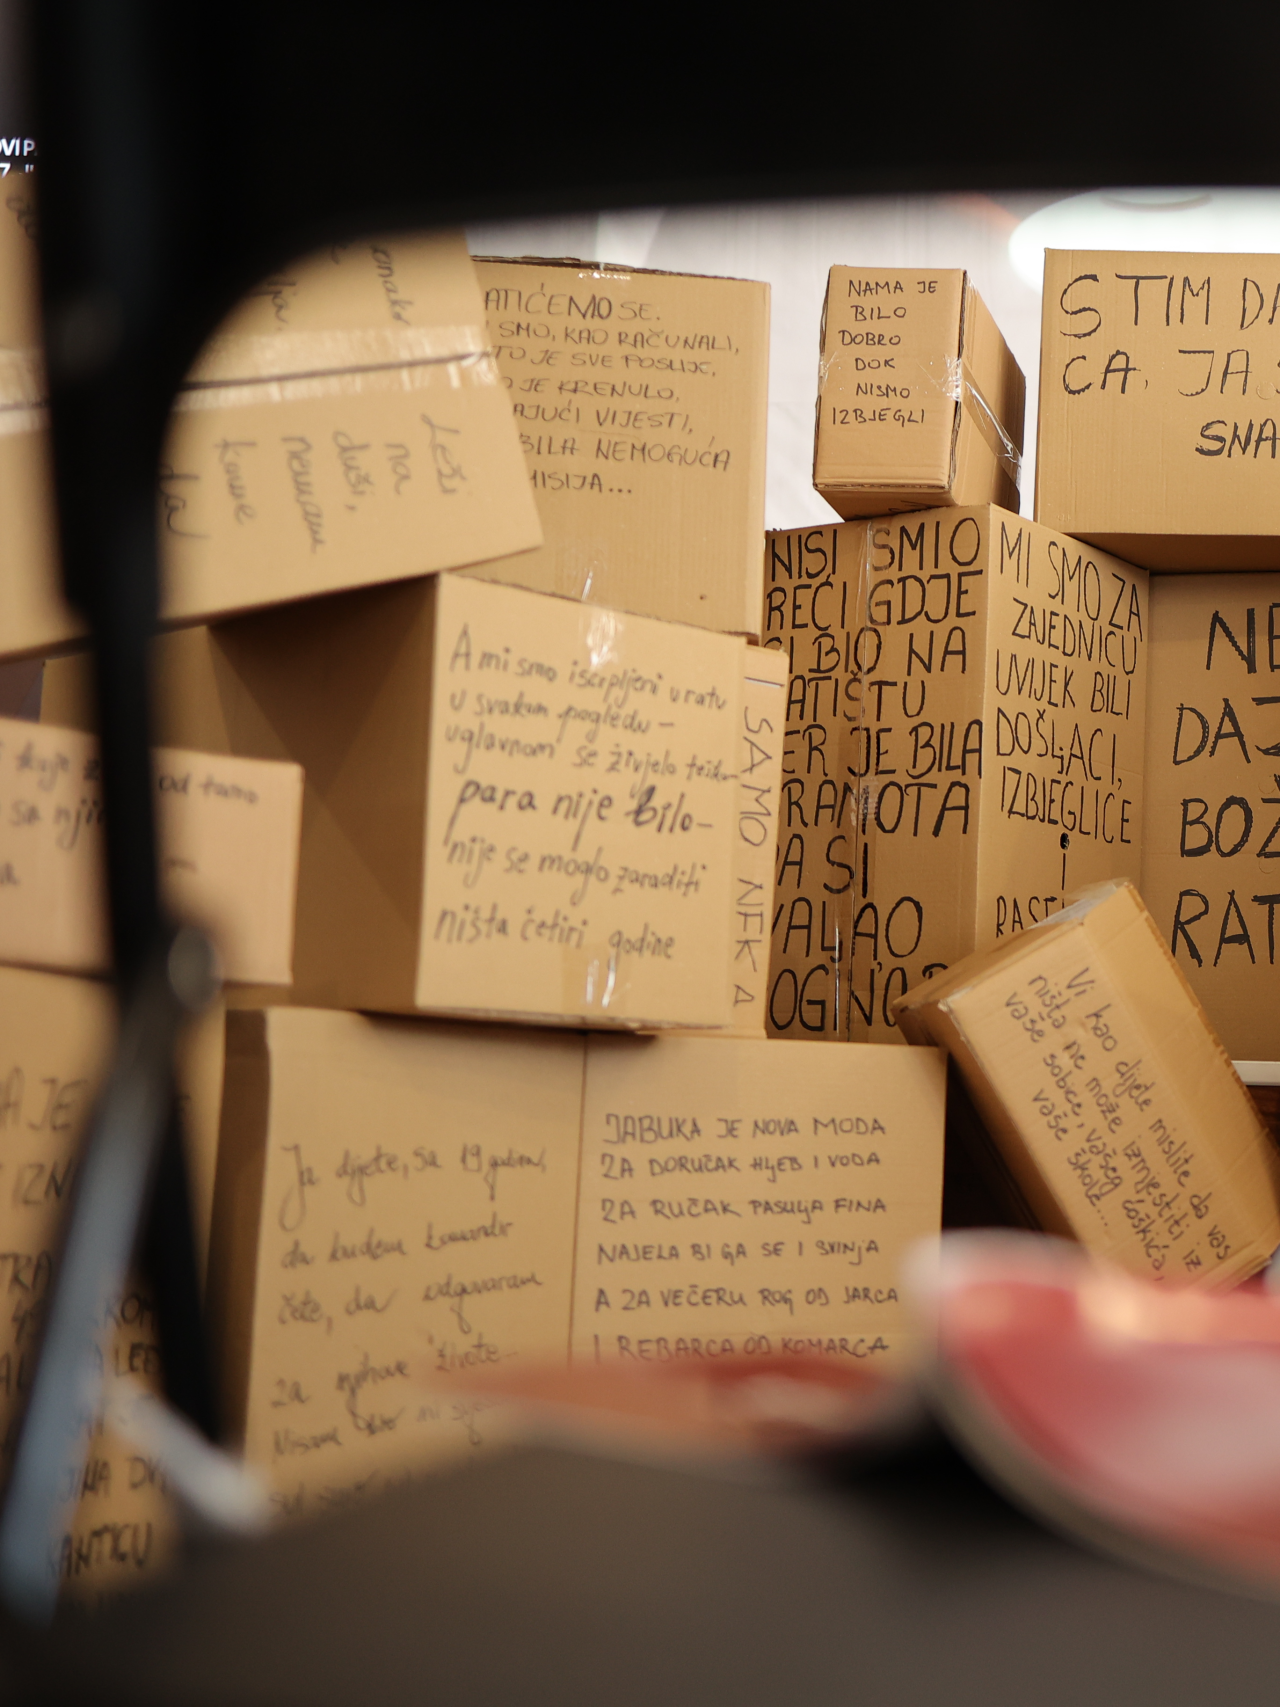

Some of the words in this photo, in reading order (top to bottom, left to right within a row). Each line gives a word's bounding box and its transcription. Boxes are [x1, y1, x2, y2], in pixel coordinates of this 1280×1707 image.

[848, 280, 903, 297] NAMA
[917, 281, 938, 294] JE
[851, 305, 906, 321] BILO
[531, 349, 558, 366] JE
[571, 353, 613, 368] SVE
[564, 327, 609, 345] KAO
[618, 328, 739, 354] RAČUNALI,
[838, 330, 901, 346] DOBRO
[518, 378, 550, 393] JE
[855, 358, 895, 371] DOK
[1178, 348, 1252, 397] JA
[856, 383, 910, 398] NISMO
[832, 407, 924, 427] IZBJEGLI
[595, 436, 730, 471] NEMOGUĆA
[771, 528, 838, 582] NISI
[871, 516, 981, 572] SMIO
[766, 573, 846, 631] REĆI
[868, 569, 983, 627] GDJE
[1000, 521, 1031, 587] MI
[1047, 541, 1102, 622] SMO
[1108, 572, 1143, 642] ZA
[809, 626, 882, 674] BIO
[907, 626, 967, 675] NA
[1011, 597, 1138, 675] ZAJEDNICU
[517, 656, 558, 683] smo
[996, 648, 1076, 709] UVIJEK
[1091, 671, 1132, 720] BILI
[557, 705, 651, 744] pogledu
[847, 726, 897, 777] JE
[906, 718, 983, 778] BILA
[572, 744, 599, 767] se
[607, 744, 677, 799] živjelo
[738, 706, 774, 846] SAMO
[443, 779, 538, 846] para
[552, 791, 613, 852] nije
[1000, 765, 1132, 845] IZBJEGLICE
[446, 836, 496, 889] nije
[505, 846, 530, 873] se
[538, 846, 609, 906] moglo
[614, 864, 707, 895] zaraditi
[824, 834, 869, 899] SI
[434, 903, 509, 944] ništa
[520, 905, 589, 949] četiri
[607, 923, 675, 975] godine
[1005, 991, 1046, 1043] vaše
[1028, 973, 1071, 1029] ništa
[1062, 1039, 1087, 1070] ne
[1085, 1076, 1123, 1134] može
[1065, 967, 1095, 997] Vi
[1085, 1004, 1117, 1051] kao
[1149, 1118, 1194, 1187] mislite
[602, 1114, 702, 1144] JABUKA
[716, 1118, 742, 1139] JE
[752, 1119, 798, 1138] NOVA
[813, 1117, 886, 1136] MODA
[1031, 1089, 1068, 1141] vaše
[650, 1154, 741, 1176] DORUČAK
[829, 1152, 880, 1168] VODA
[650, 1198, 742, 1219] RUČAK
[834, 1199, 887, 1214] FINA
[597, 1243, 679, 1264] NAJELA
[691, 1242, 712, 1260] BI
[762, 1242, 784, 1257] SE
[660, 1285, 747, 1308] VEČERU
[805, 1289, 829, 1306] OD
[844, 1286, 898, 1304] JARCA
